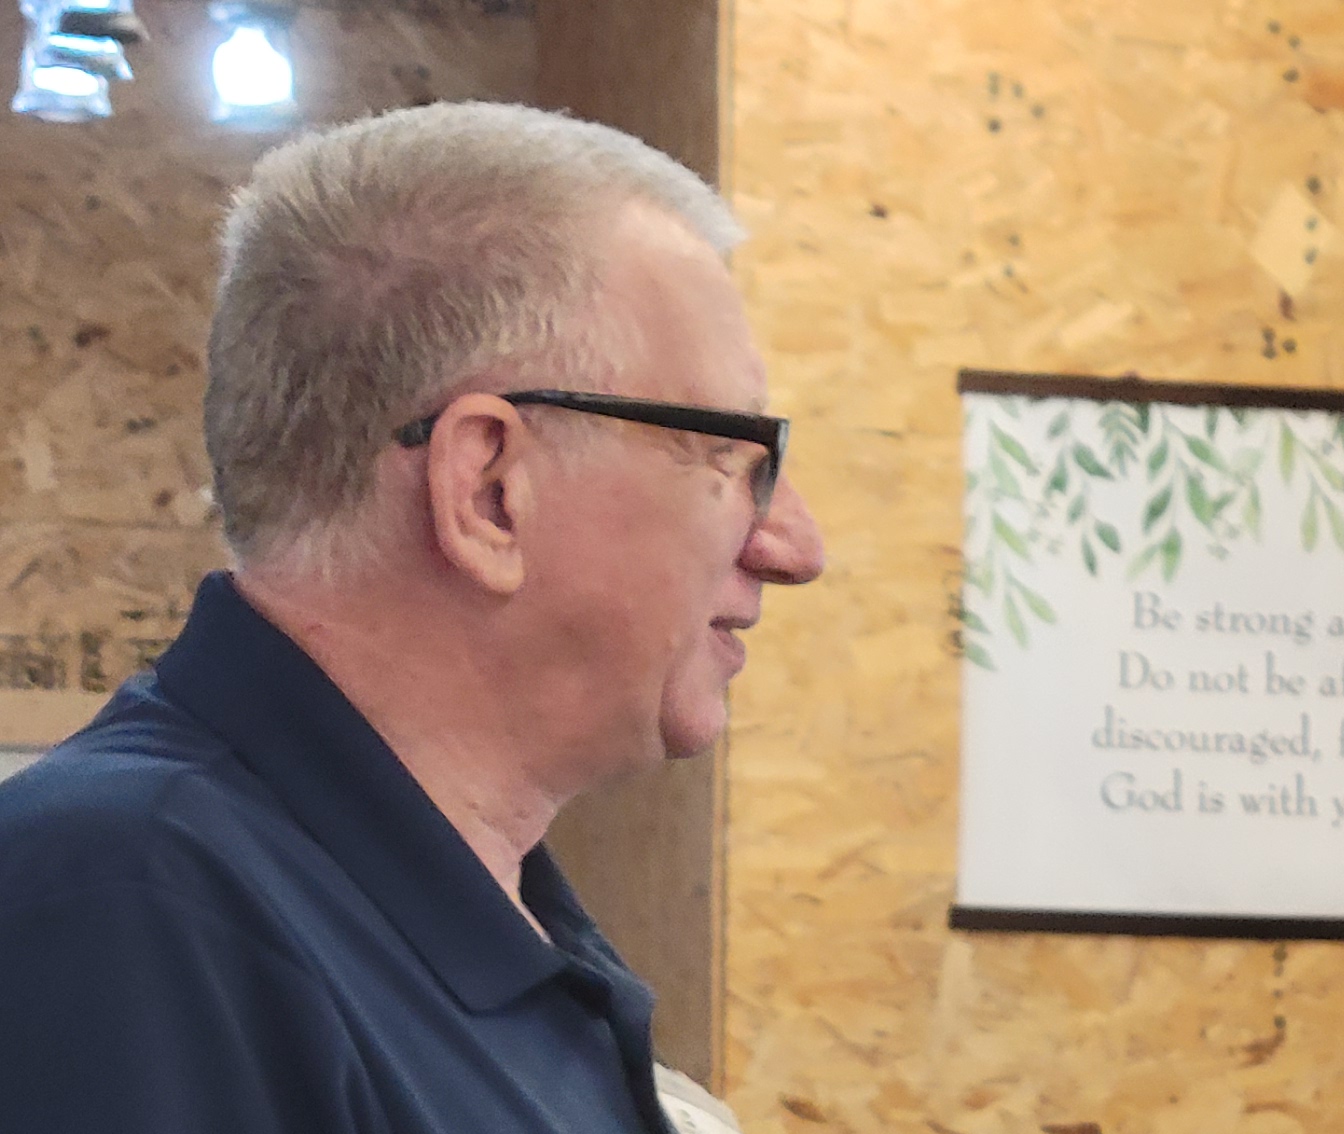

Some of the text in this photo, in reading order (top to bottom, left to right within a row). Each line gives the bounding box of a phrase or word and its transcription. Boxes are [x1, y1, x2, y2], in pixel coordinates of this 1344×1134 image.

[1132, 590, 1183, 631] Be
[1195, 601, 1315, 645] strong
[1118, 650, 1175, 691] Do
[1187, 662, 1249, 695] not
[1264, 650, 1306, 696] be
[1090, 704, 1322, 765] discouraged,
[1100, 767, 1184, 813] God
[1198, 780, 1225, 814] is
[1239, 772, 1318, 818] with
